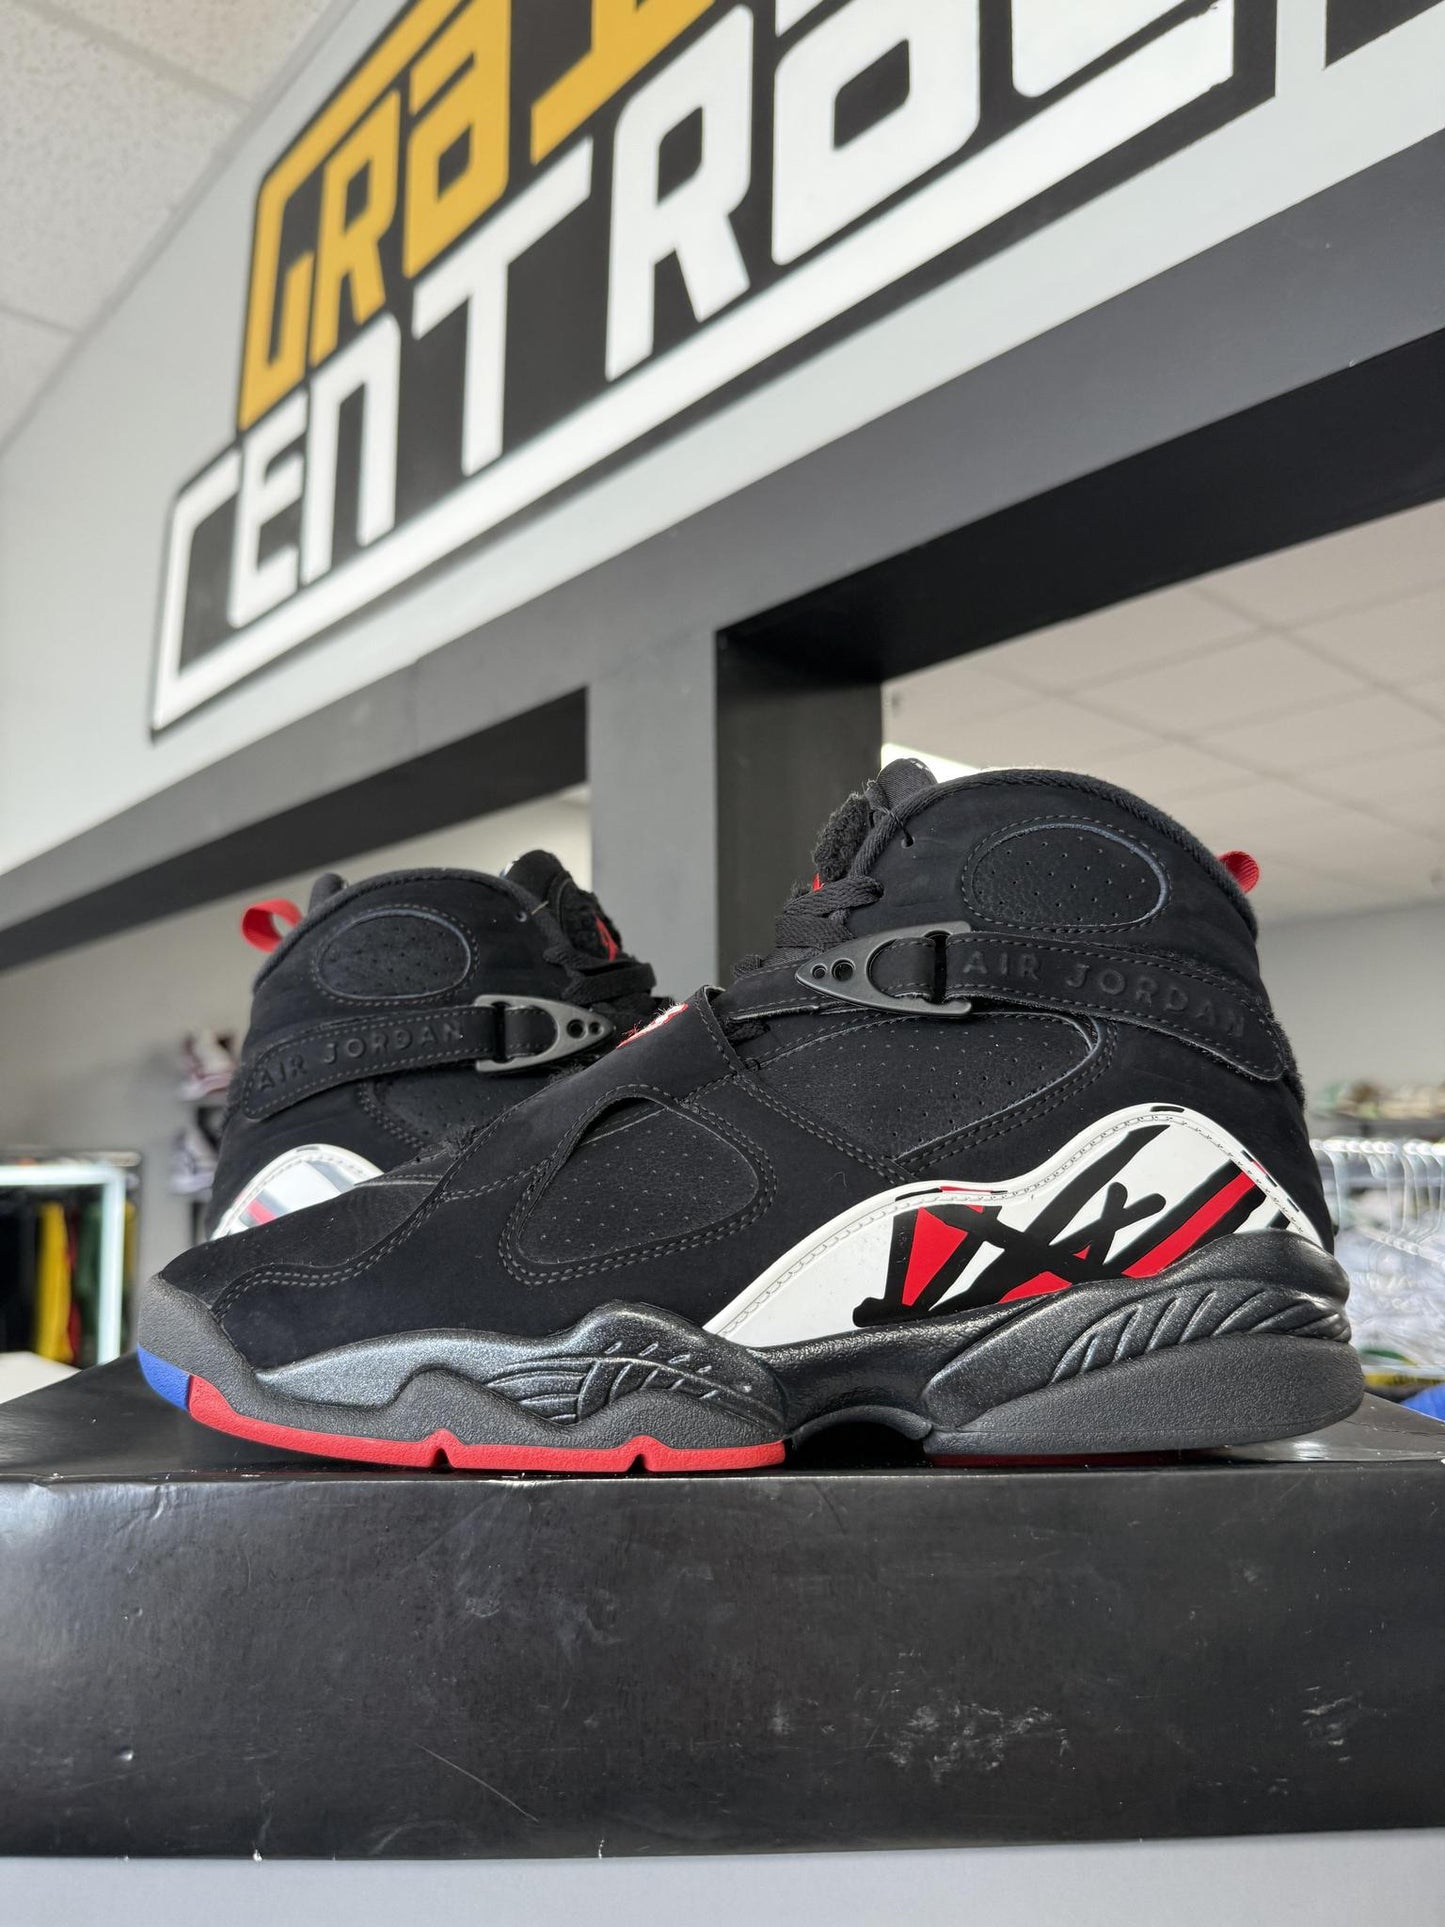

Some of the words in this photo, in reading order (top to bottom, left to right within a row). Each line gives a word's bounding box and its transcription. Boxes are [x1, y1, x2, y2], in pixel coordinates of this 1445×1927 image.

[962, 950, 1041, 981] AIR
[1065, 962, 1246, 1038] JORDAN
[258, 1053, 308, 1092] AIR
[322, 1020, 464, 1065] JORDAN
